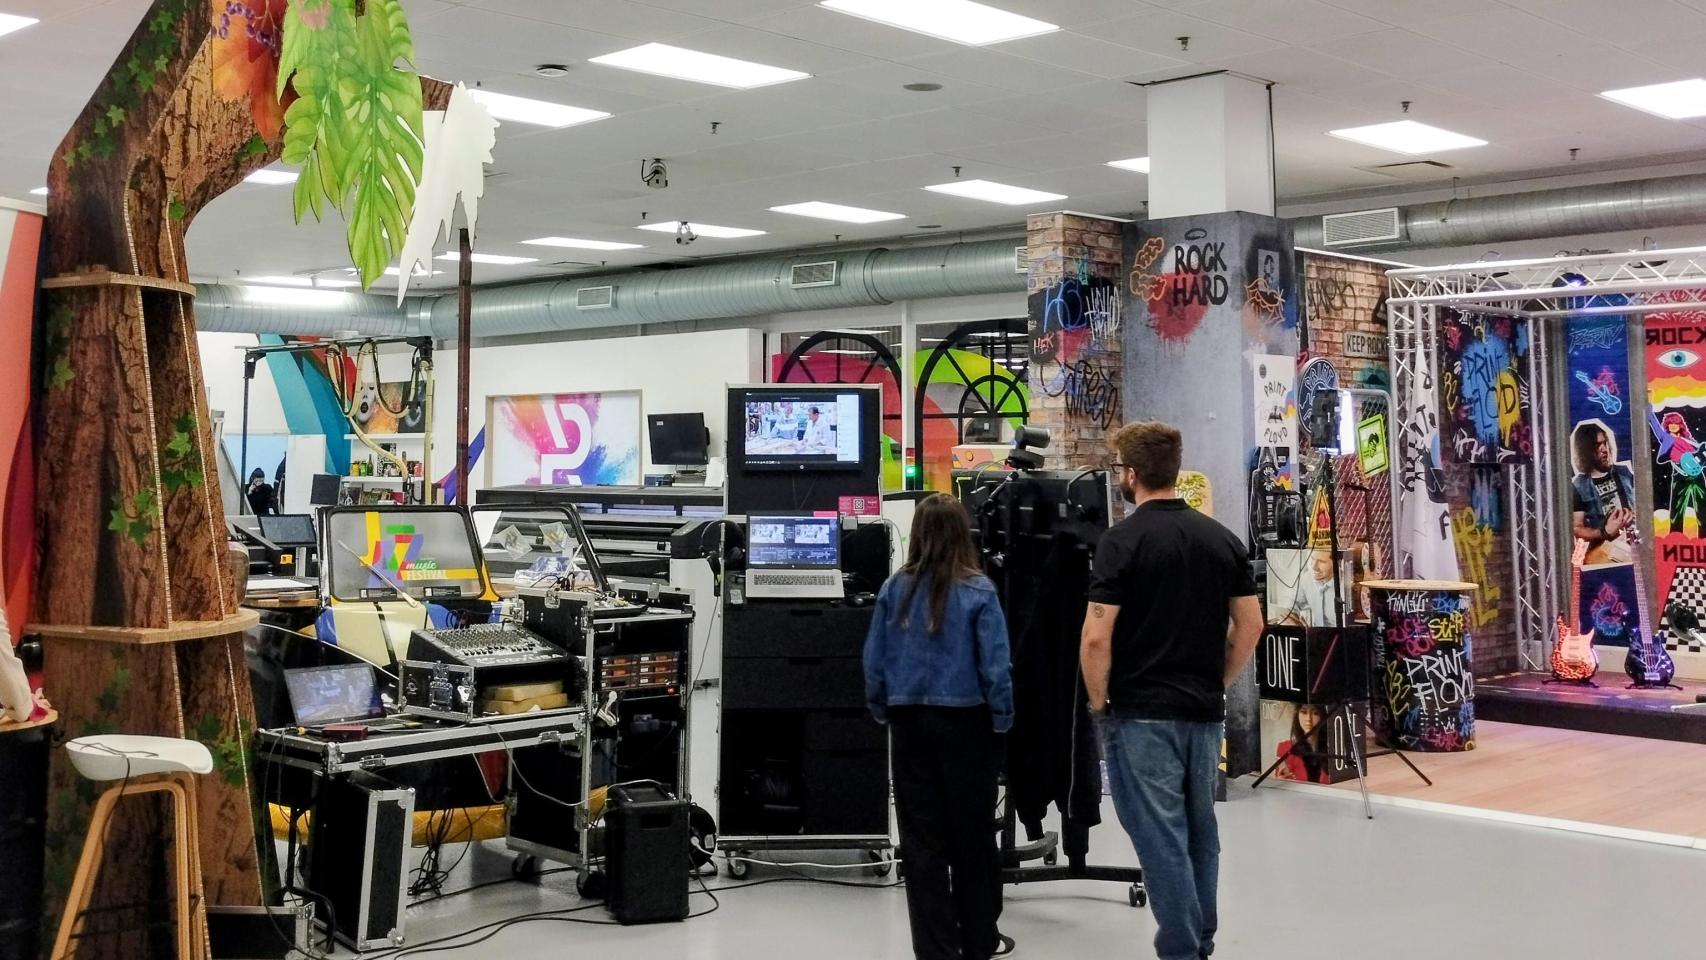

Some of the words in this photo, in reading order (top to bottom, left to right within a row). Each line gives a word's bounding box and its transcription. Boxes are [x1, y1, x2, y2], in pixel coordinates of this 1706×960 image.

[1174, 242, 1227, 275] ROCK
[1173, 274, 1229, 306] HARD
[1346, 334, 1366, 353] KEEP
[1263, 380, 1287, 398] PRINT
[1263, 427, 1288, 444] FLOYD
[405, 559, 437, 570] music
[406, 569, 449, 580] FESTIVAL
[1266, 633, 1301, 692] ONE
